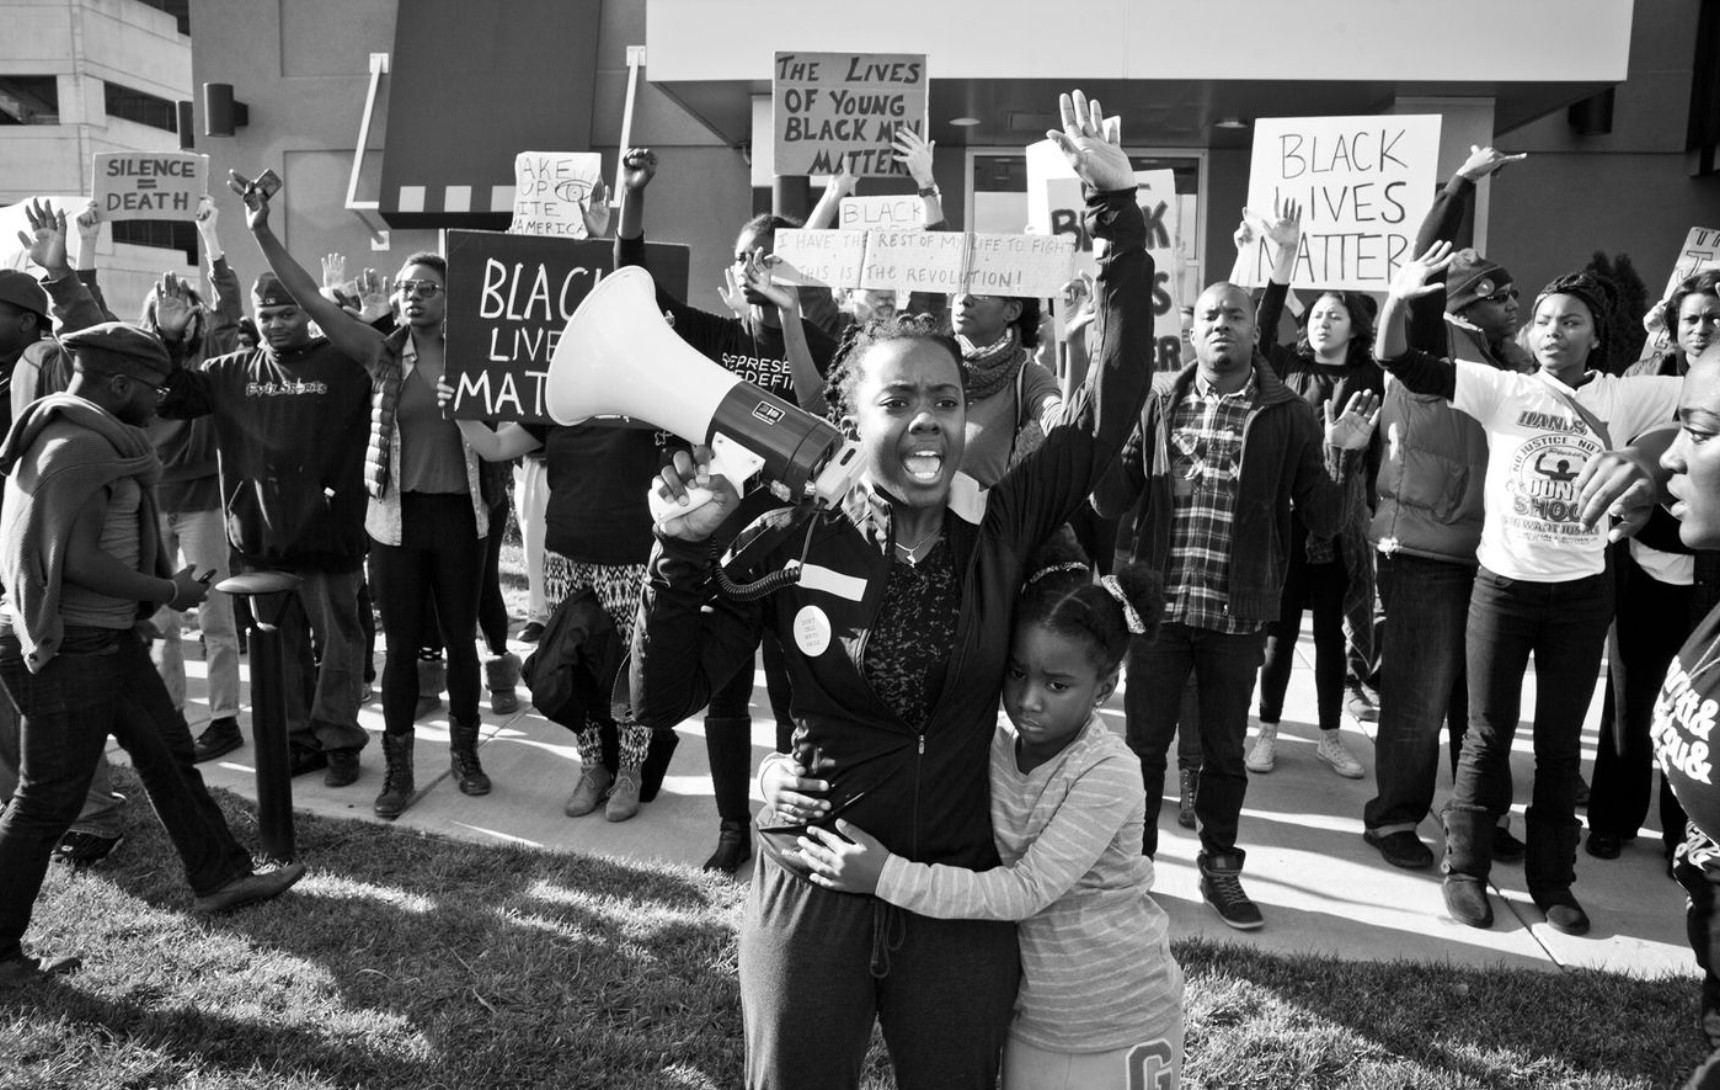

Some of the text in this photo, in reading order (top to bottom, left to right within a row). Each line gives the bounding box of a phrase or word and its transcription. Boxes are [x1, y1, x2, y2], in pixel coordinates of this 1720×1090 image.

[777, 54, 921, 84] THE LIVES
[784, 88, 905, 117] OF YOUNG
[784, 116, 867, 142] BLACK
[1279, 129, 1409, 179] BLACK
[106, 159, 195, 178] SILENCE
[522, 157, 573, 180] AKE
[107, 192, 189, 211] DEATH
[519, 201, 561, 217] ITE
[843, 201, 922, 223] BLACK
[778, 232, 789, 249] I
[795, 232, 835, 250] HAVE
[878, 232, 918, 248] REST
[919, 234, 935, 248] OF
[940, 235, 964, 250] MY
[1007, 237, 1024, 253] TO
[479, 257, 602, 322] BLAC
[798, 265, 829, 281] THIS
[840, 265, 853, 280] IS
[906, 267, 1022, 291] REVOLUTION!
[489, 327, 564, 362] LIVE
[721, 352, 791, 374] REPRESE
[454, 369, 548, 416] MAT
